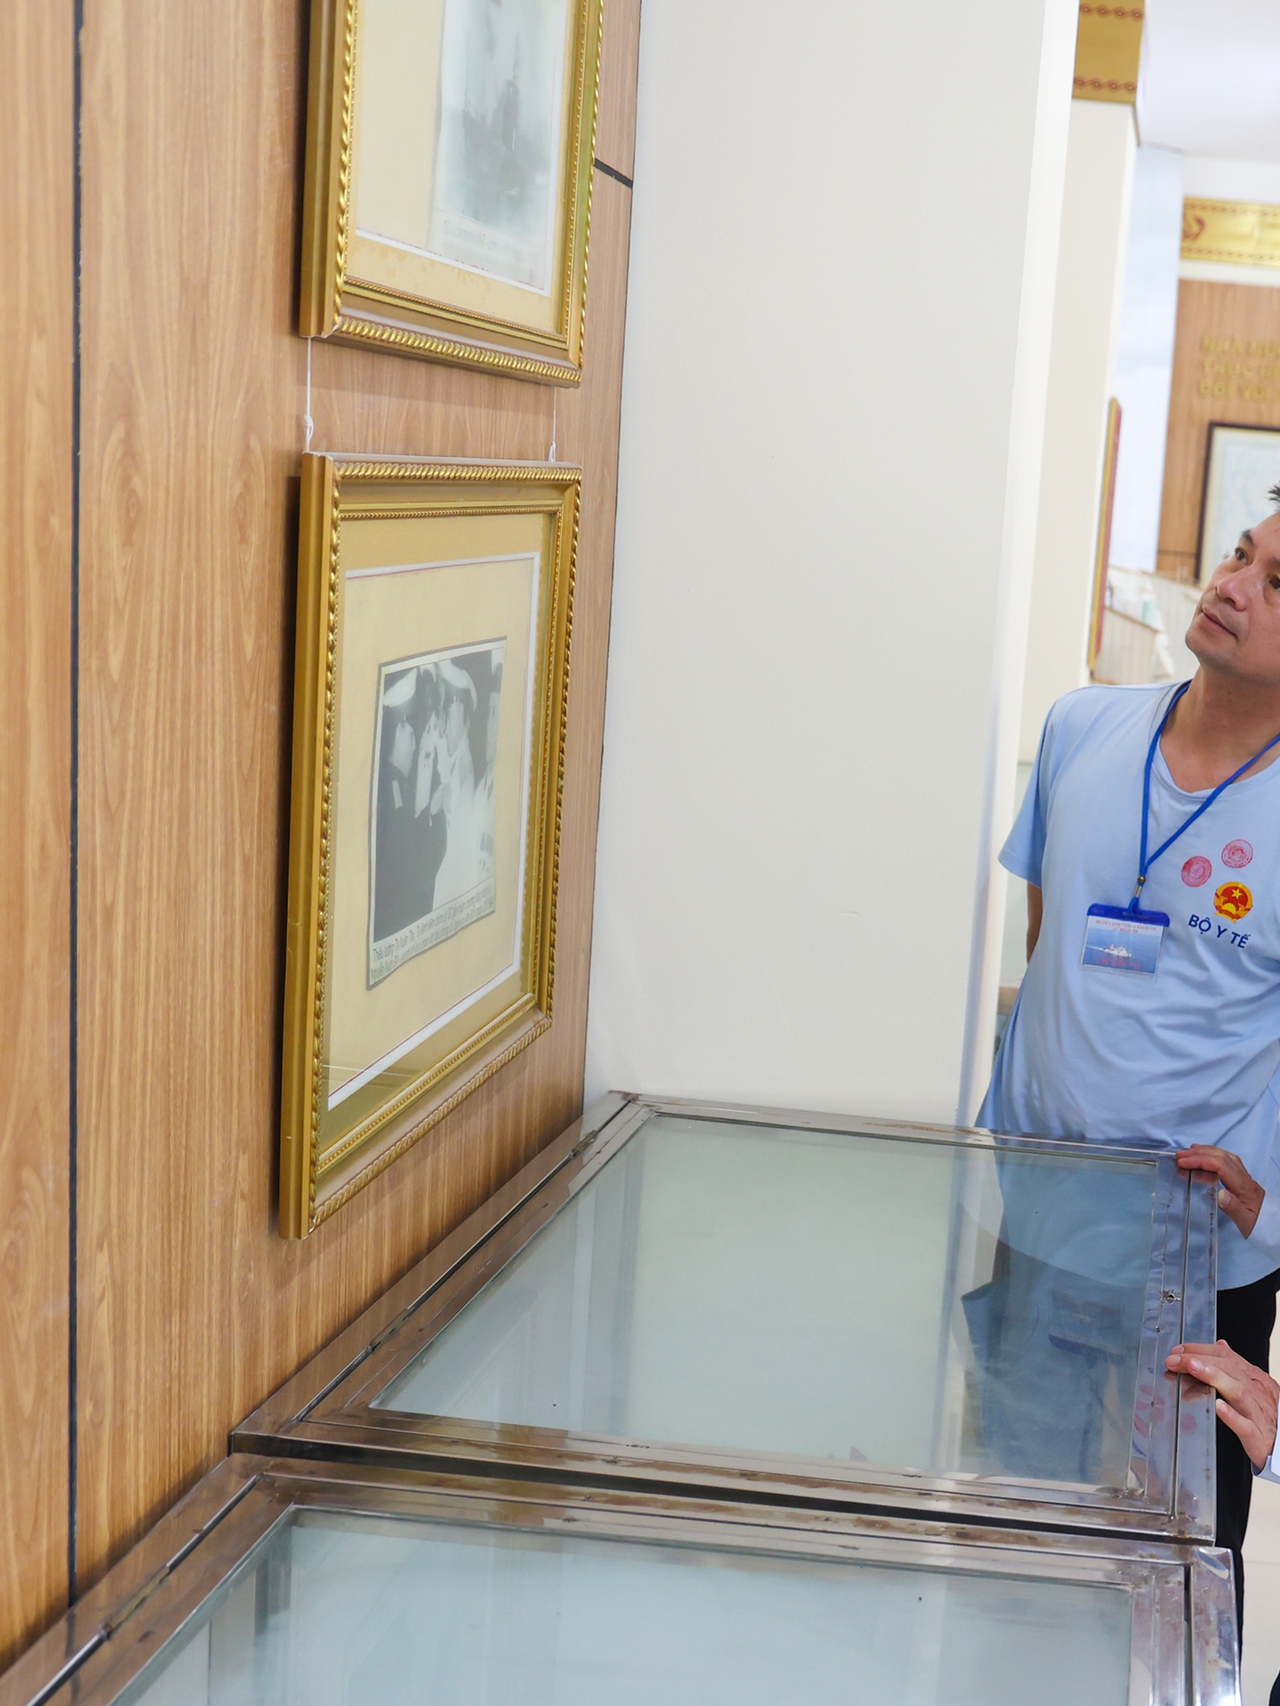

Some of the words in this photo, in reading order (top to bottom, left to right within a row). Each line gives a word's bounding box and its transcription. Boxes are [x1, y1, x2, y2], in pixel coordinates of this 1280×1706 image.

[1188, 914, 1211, 934] BỘ
[1217, 925, 1228, 938] Y
[1230, 931, 1251, 949] TẾ
